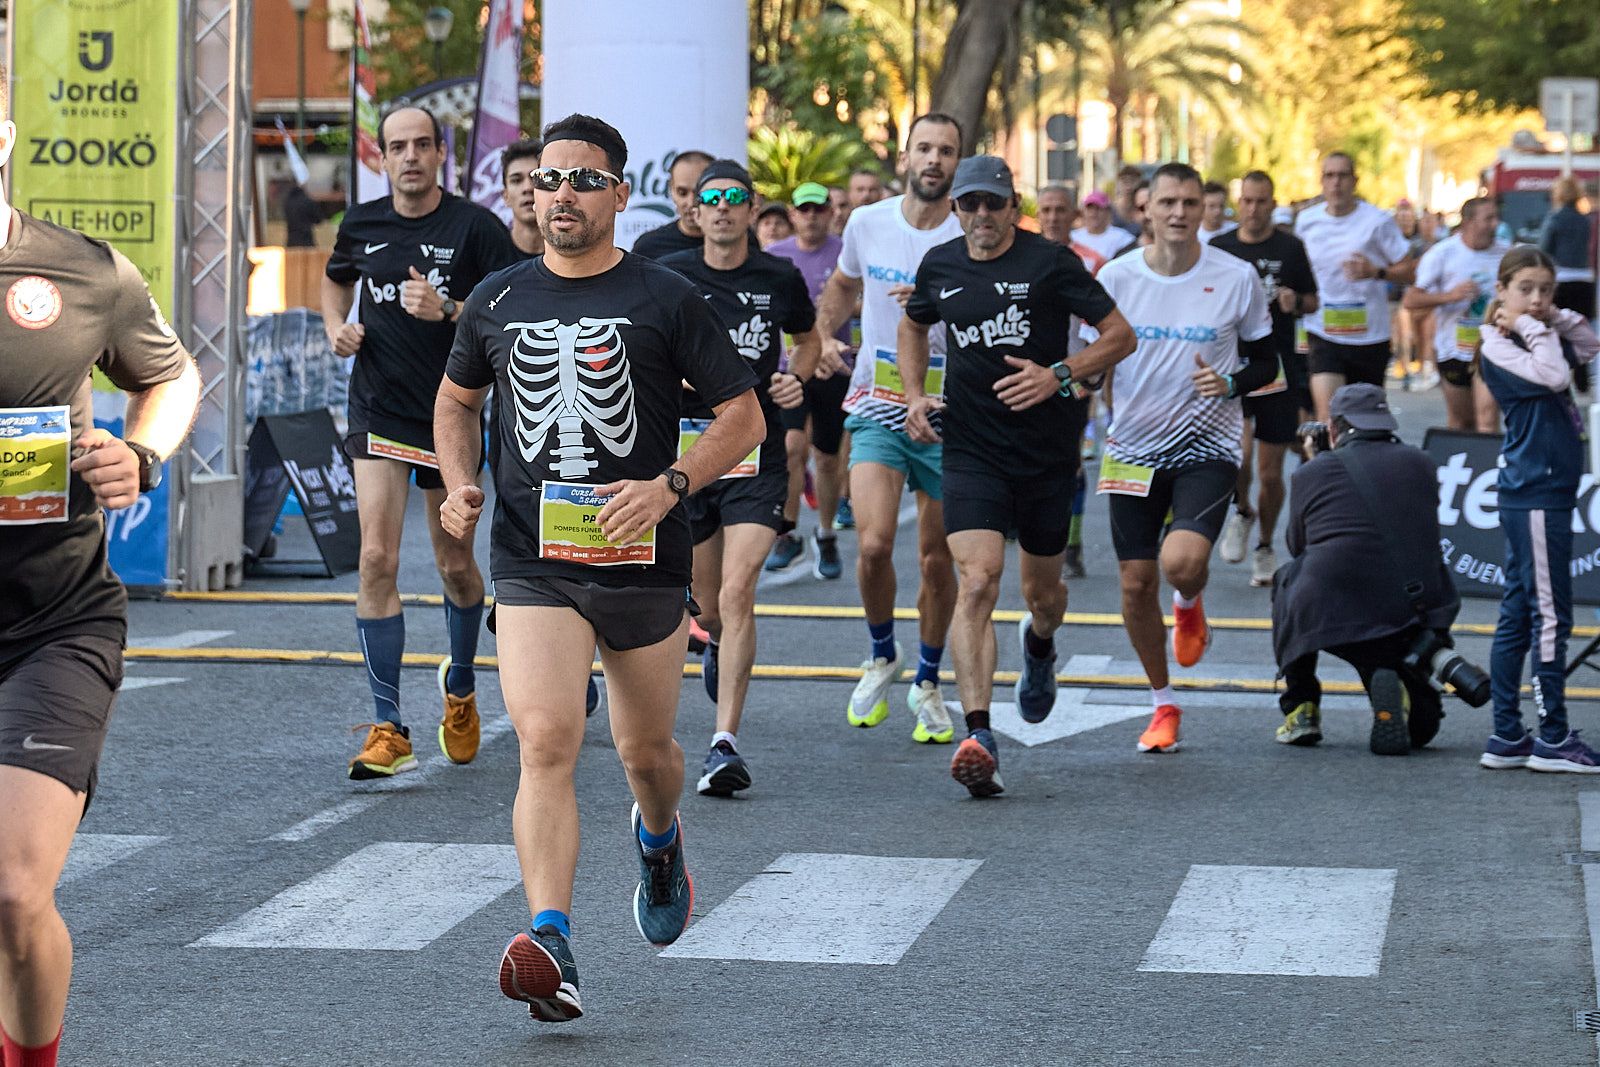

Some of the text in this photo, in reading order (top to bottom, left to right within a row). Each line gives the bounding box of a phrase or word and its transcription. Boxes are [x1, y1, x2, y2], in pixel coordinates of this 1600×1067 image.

[30, 133, 157, 168] ZOOKÖ
[584, 496, 609, 505] SAFOR
[582, 514, 598, 524] PA
[553, 525, 580, 533] POMPES
